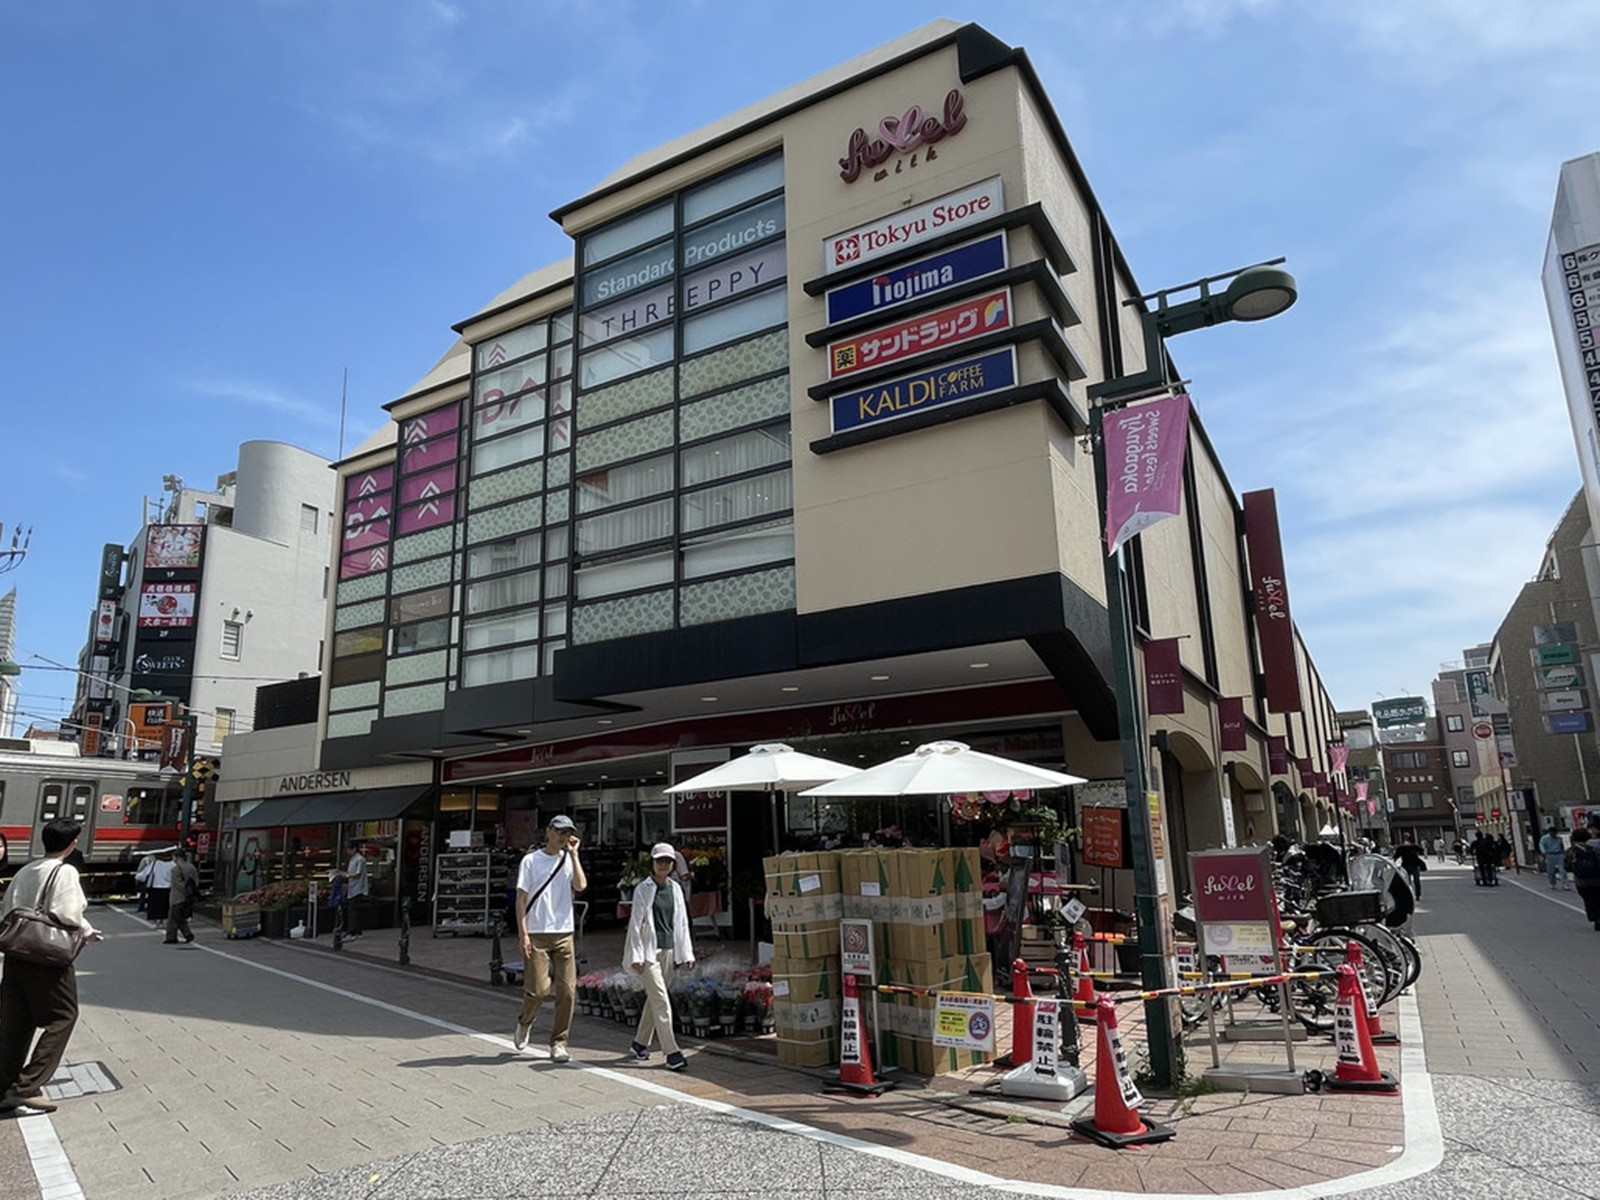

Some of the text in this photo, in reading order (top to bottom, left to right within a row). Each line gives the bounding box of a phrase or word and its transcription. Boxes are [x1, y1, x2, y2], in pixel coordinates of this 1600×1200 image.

[684, 219, 776, 265] Products
[862, 195, 991, 251] Tokyu Store
[1563, 255, 1577, 270] 6
[1568, 273, 1581, 288] 6
[602, 261, 765, 337] THREEPPY
[872, 265, 954, 306] nojima
[1572, 293, 1585, 307] 6
[860, 308, 979, 362] サンドラッグ
[1576, 312, 1588, 327] 5
[1580, 331, 1593, 347] 5
[1585, 352, 1595, 365] 4
[859, 363, 983, 420] KALDI COFFEE
[939, 376, 984, 398] FARM
[279, 771, 351, 793] ANDERSEN
[417, 825, 430, 903] ANDERSEN
[1036, 1014, 1055, 1067] 駐輪禁止
[1337, 1007, 1358, 1054] 駐輪禁止
